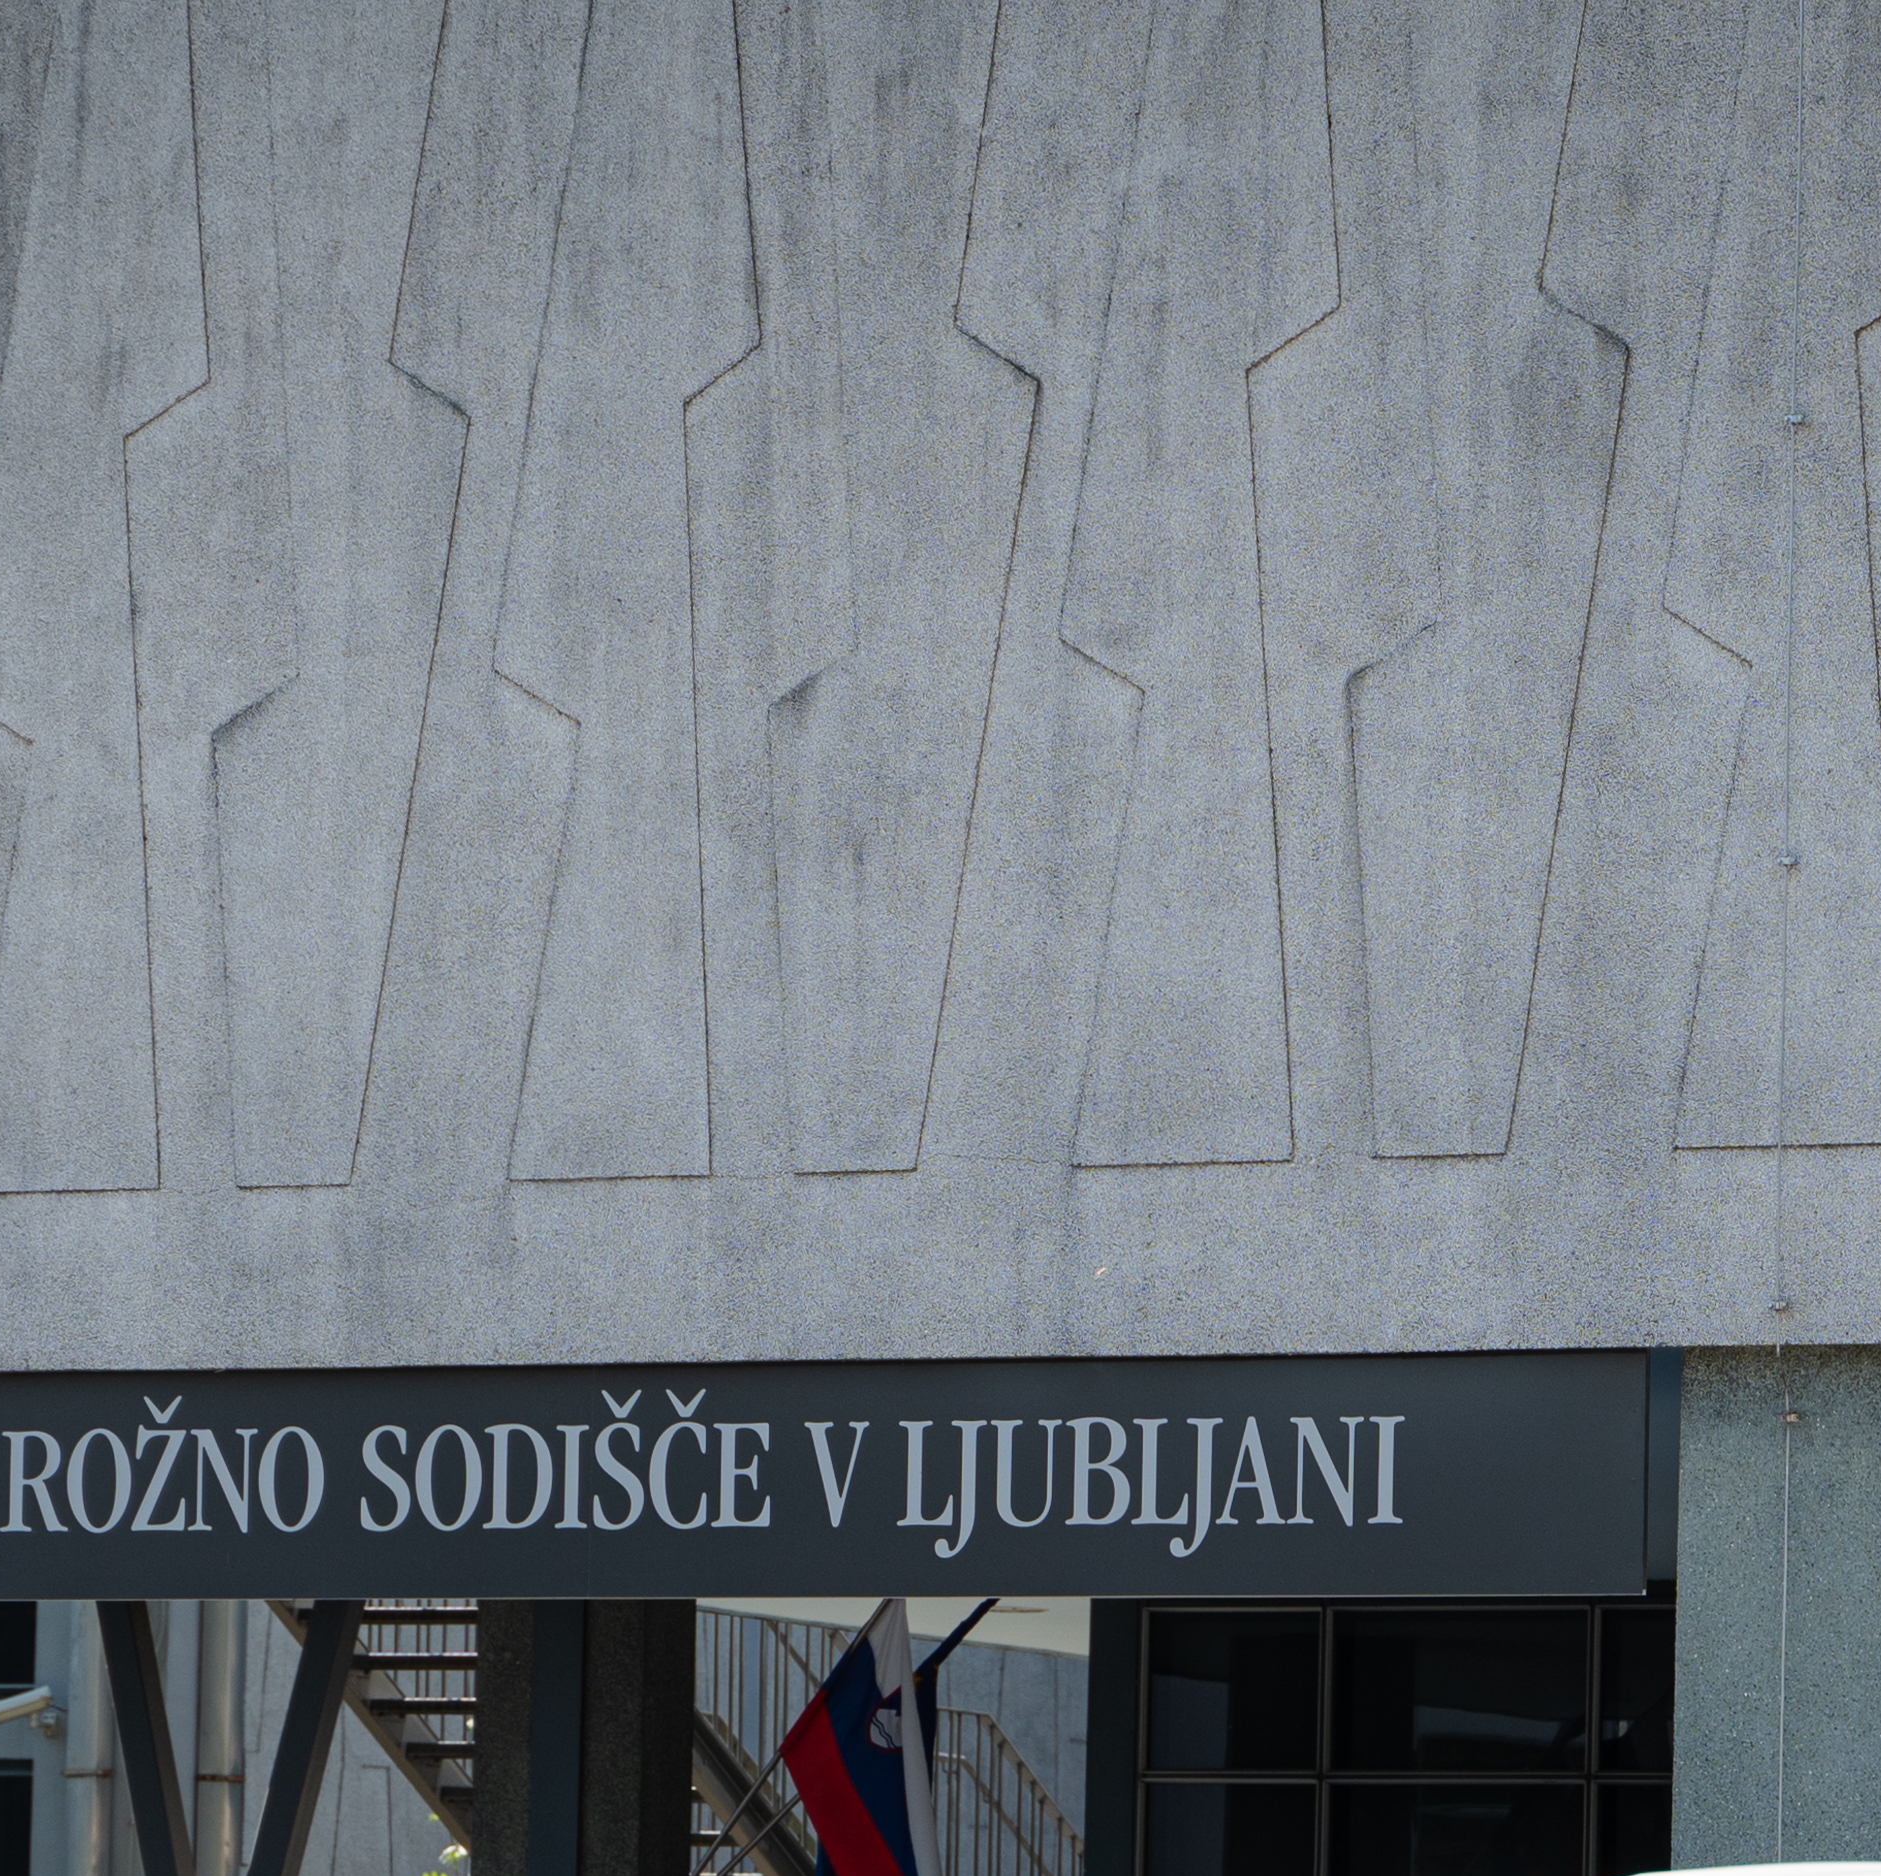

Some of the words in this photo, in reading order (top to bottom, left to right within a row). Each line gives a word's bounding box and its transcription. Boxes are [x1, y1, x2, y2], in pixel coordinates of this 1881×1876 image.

[360, 1388, 771, 1532] SODIŠČE
[804, 1421, 870, 1528] V
[896, 1415, 1406, 1558] LJUBLJANI
